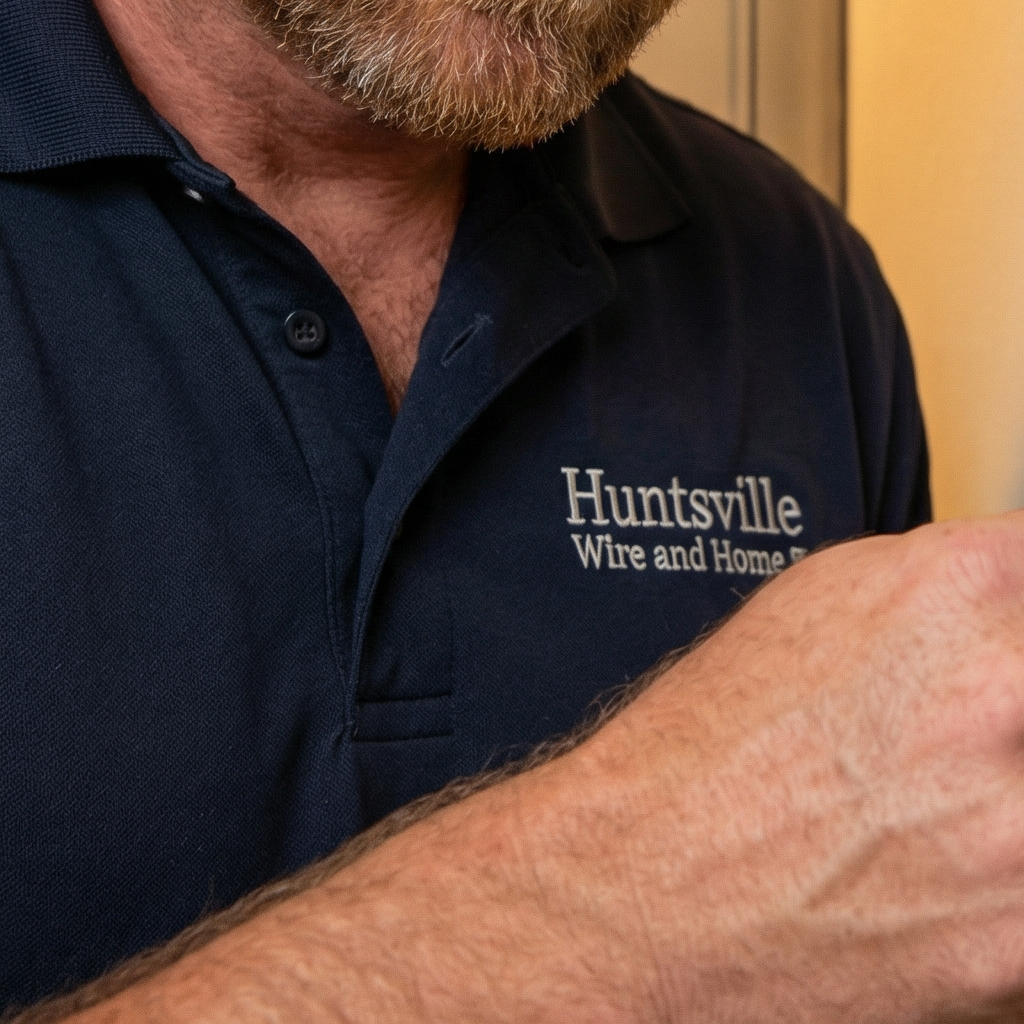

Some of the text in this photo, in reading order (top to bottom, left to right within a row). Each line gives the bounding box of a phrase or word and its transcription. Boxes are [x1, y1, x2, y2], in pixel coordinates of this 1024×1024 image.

[560, 467, 803, 536] Huntsville
[570, 533, 647, 570] Wire
[653, 535, 708, 572] and
[709, 538, 785, 576] Home
